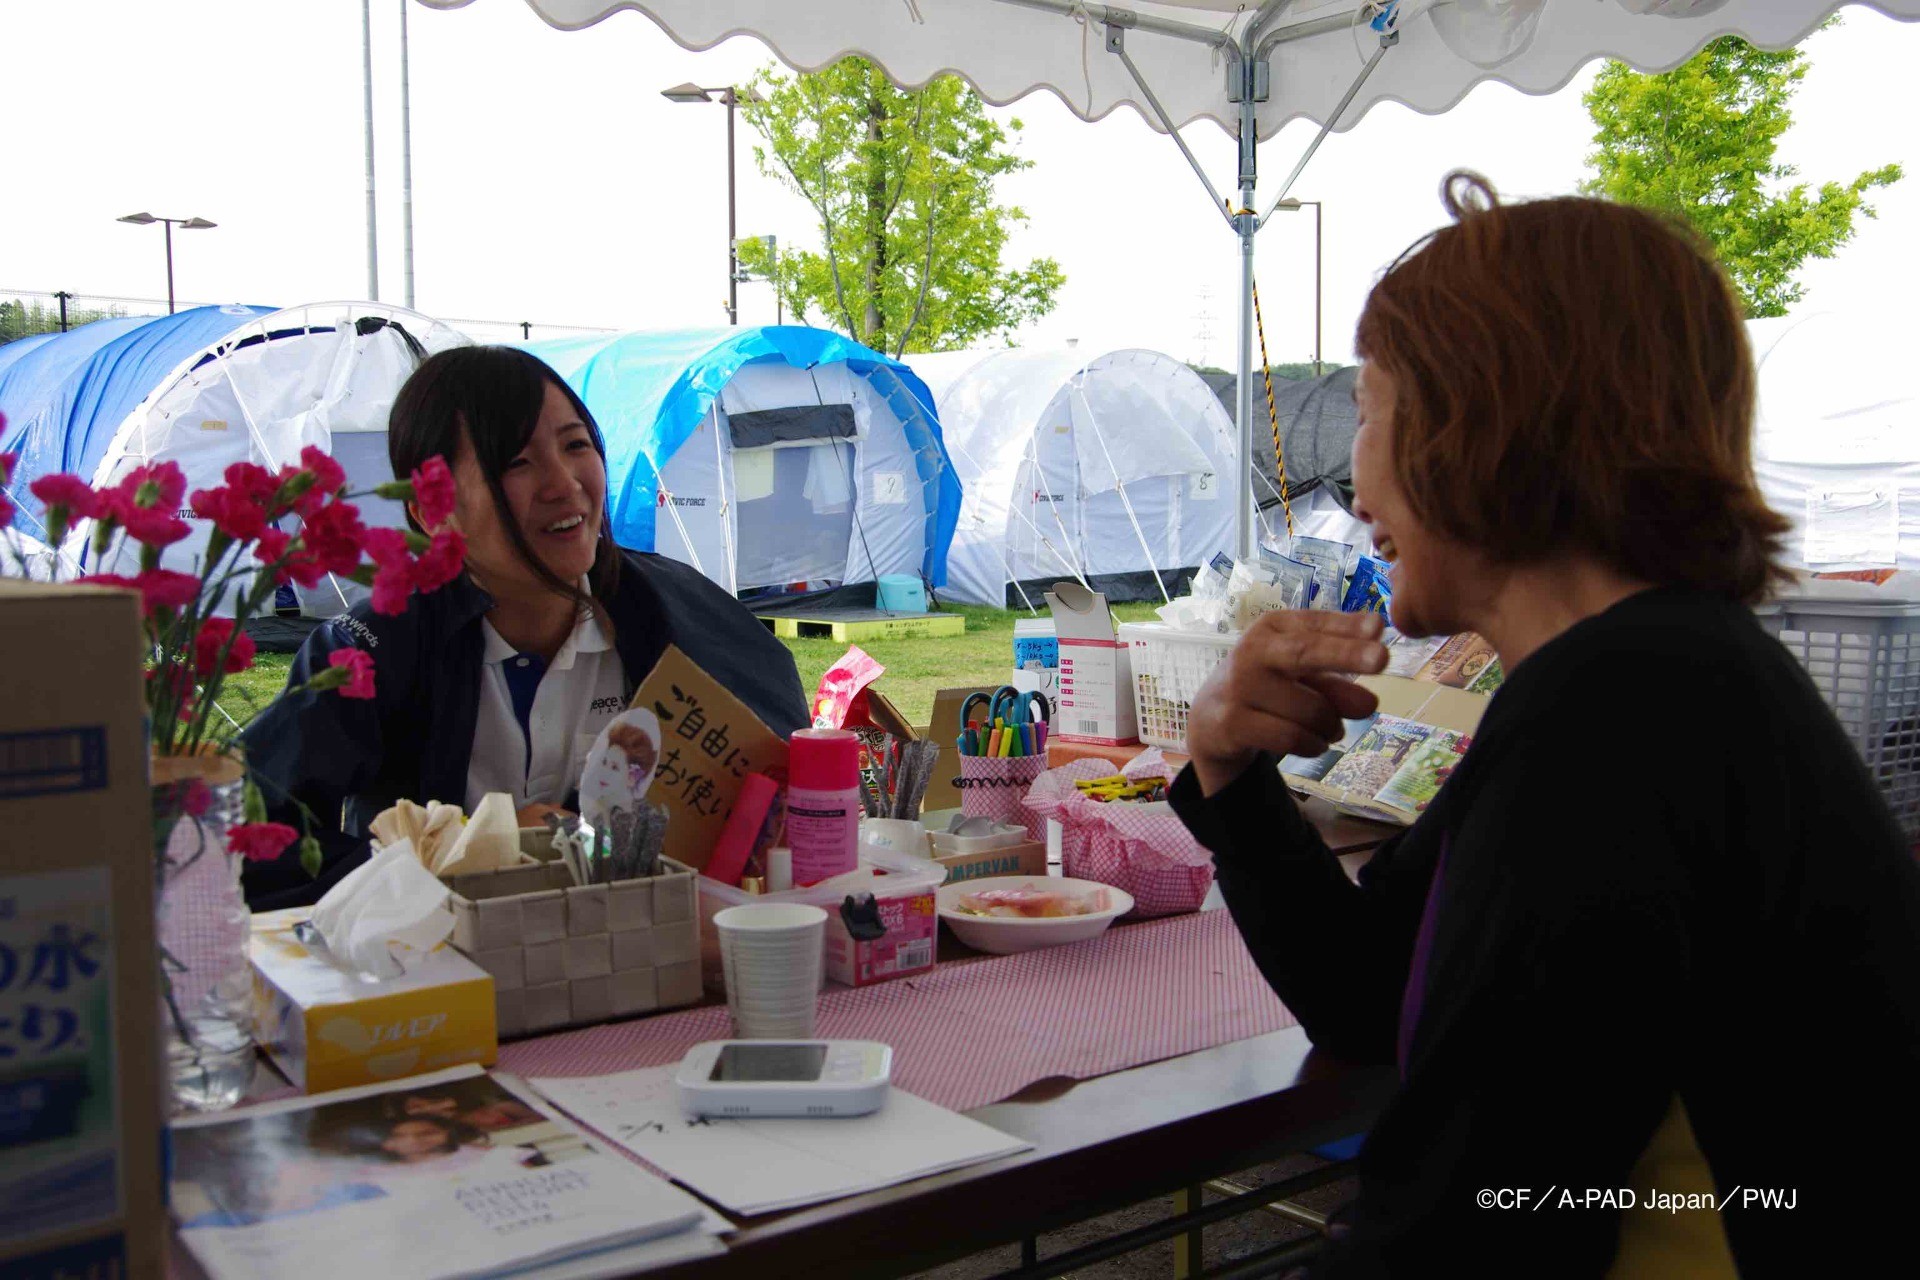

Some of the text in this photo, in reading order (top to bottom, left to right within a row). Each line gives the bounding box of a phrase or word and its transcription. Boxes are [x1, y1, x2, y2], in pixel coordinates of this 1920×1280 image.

[685, 498, 706, 507] FORCE
[1199, 472, 1214, 490] 8
[654, 684, 749, 778] ご自由に
[654, 747, 732, 821] お使い
